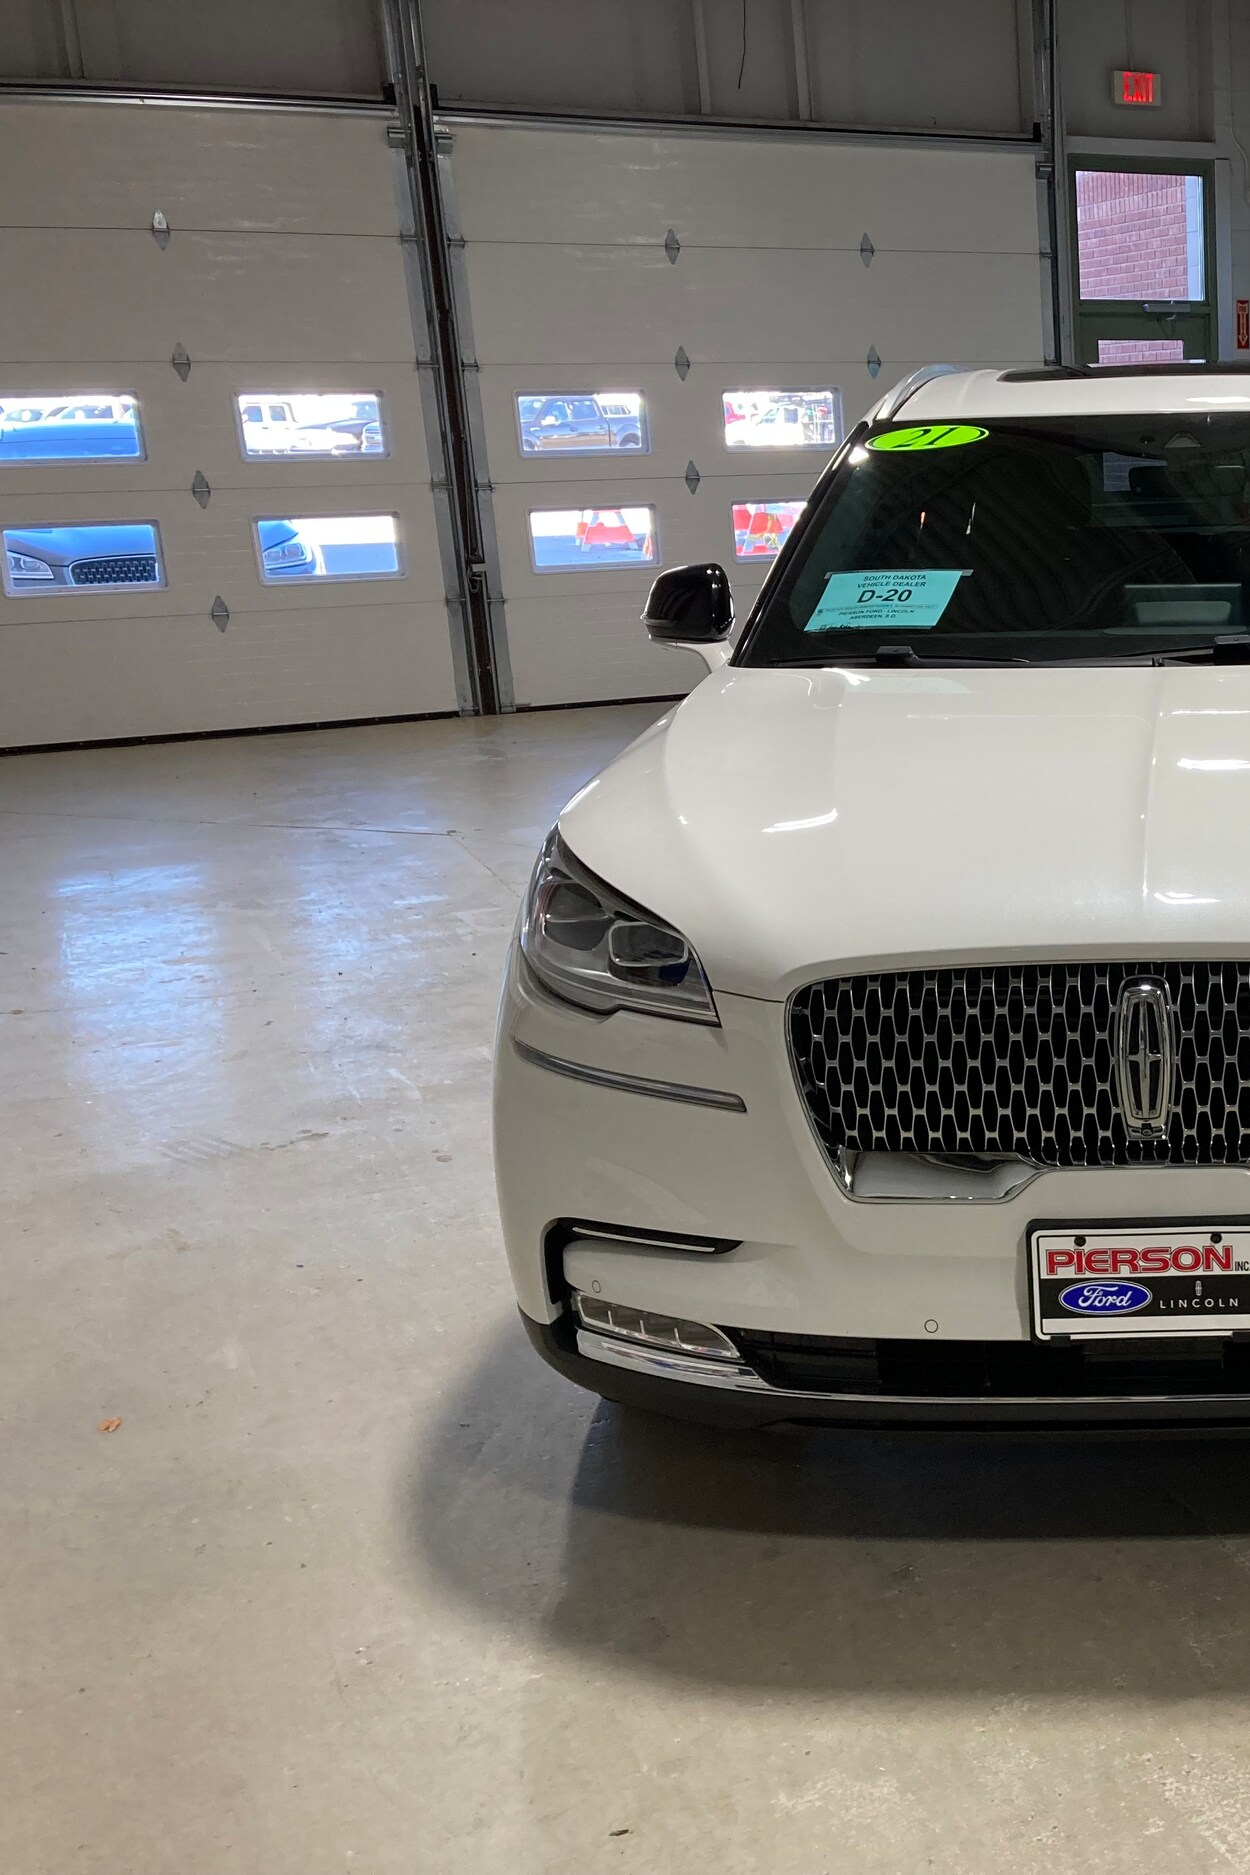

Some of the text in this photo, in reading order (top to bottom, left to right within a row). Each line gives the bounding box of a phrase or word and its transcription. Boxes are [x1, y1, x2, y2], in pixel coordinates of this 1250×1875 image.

[1123, 71, 1153, 103] EXIT
[889, 426, 961, 449] 21
[857, 581, 890, 589] VEHICLE
[863, 574, 892, 582] SOUTH
[857, 588, 913, 604] D-20
[1046, 1244, 1234, 1276] PIERSON
[1077, 1285, 1133, 1308] Ford
[1159, 1298, 1239, 1310] LINCOLN
